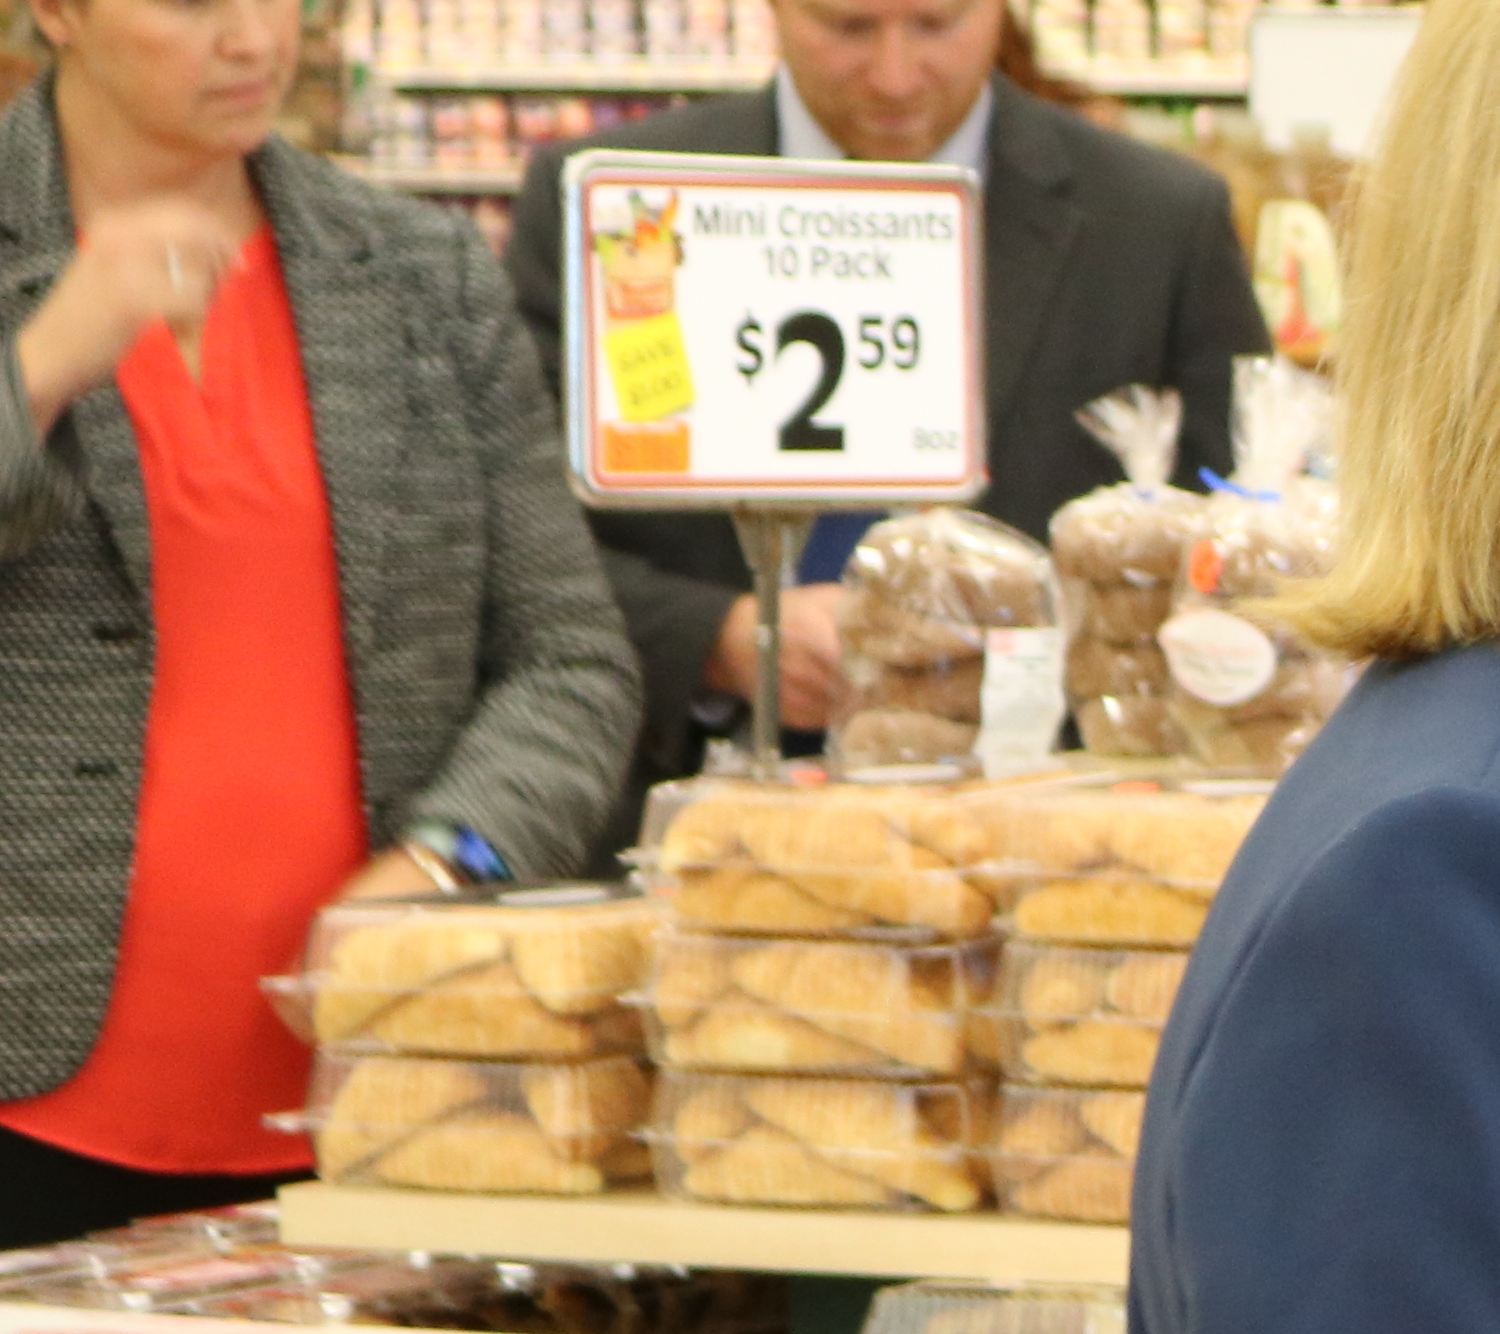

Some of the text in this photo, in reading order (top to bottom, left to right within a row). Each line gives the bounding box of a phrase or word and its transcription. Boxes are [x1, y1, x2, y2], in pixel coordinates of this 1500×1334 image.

[694, 204, 953, 241] Mini Croissants
[763, 244, 894, 280] 10 Pack
